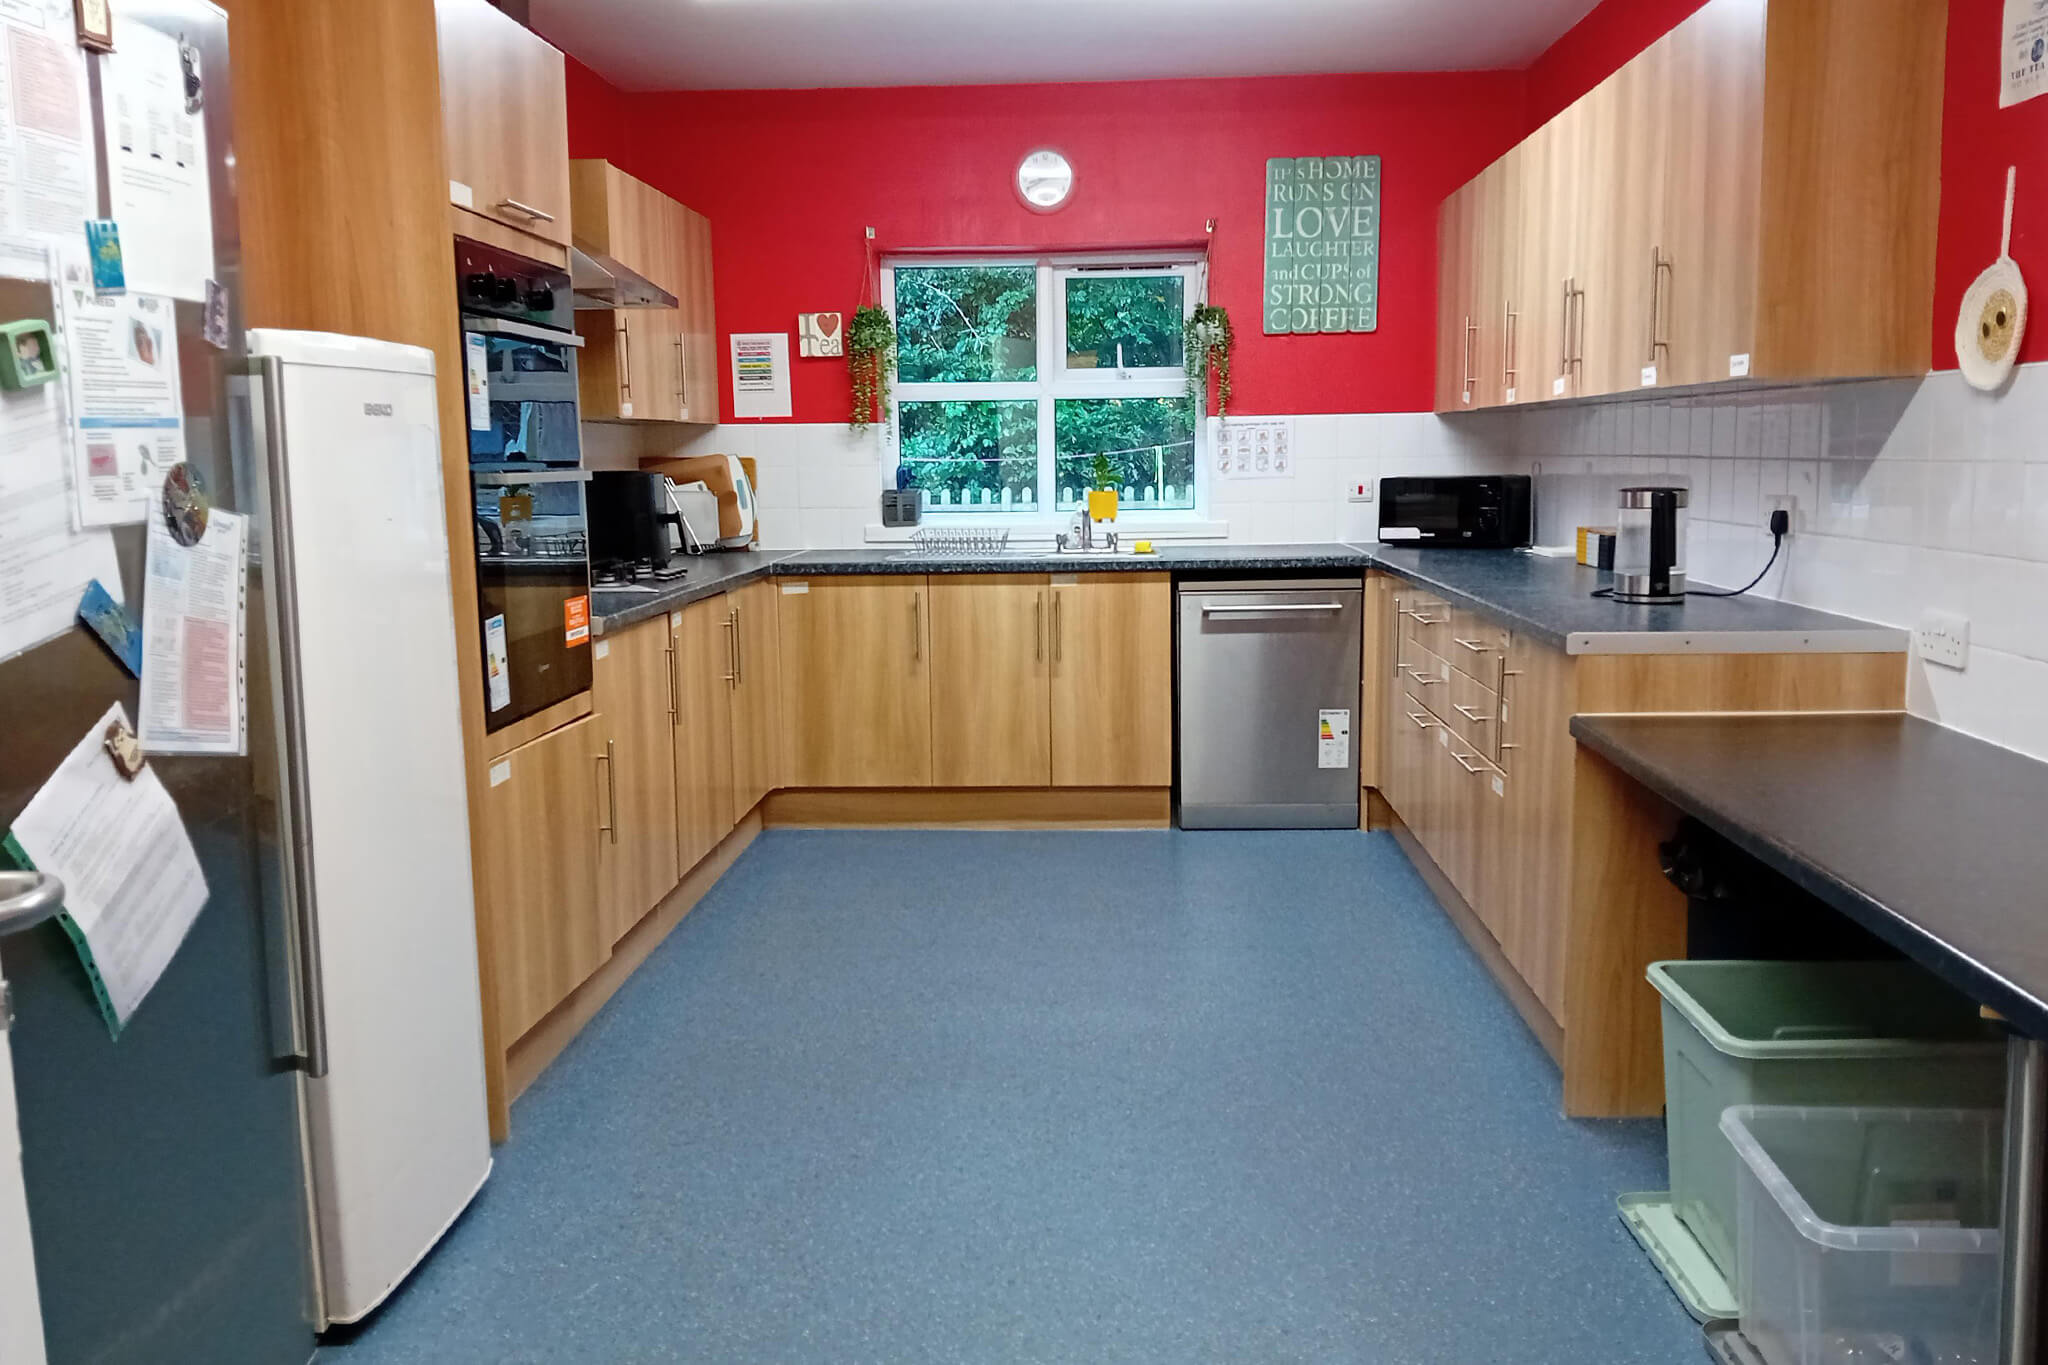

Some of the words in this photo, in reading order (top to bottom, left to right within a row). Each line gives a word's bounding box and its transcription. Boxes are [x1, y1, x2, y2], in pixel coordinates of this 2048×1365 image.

[1273, 167, 1305, 181] THS
[1309, 160, 1377, 180] HOME
[1273, 182, 1334, 202] RUNS
[1341, 181, 1376, 201] ON
[1272, 206, 1374, 239] LOVE
[1272, 241, 1374, 257] LAUGHTER
[1271, 265, 1298, 281] and
[1301, 262, 1352, 281] CUPS
[1356, 262, 1373, 280] of
[1271, 283, 1372, 305] STRONG
[1269, 307, 1373, 330] COFFEE
[799, 333, 842, 357] Tea
